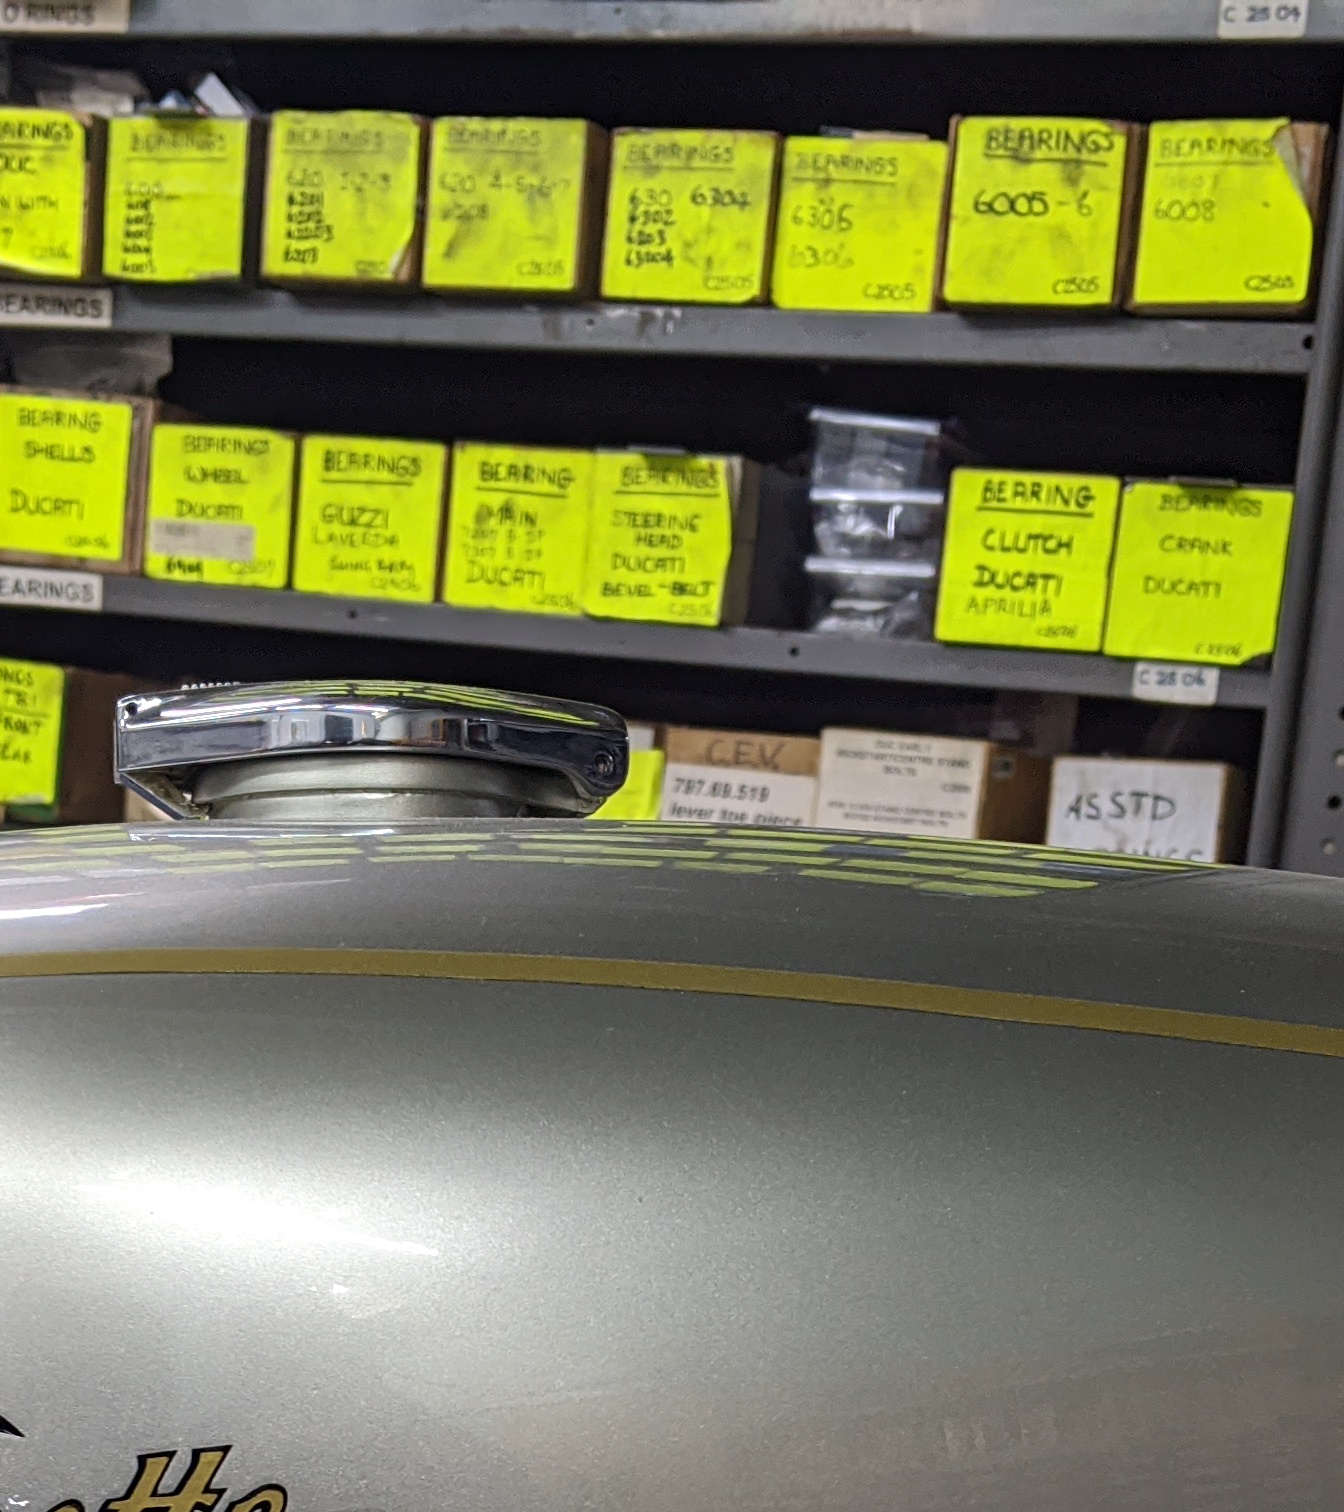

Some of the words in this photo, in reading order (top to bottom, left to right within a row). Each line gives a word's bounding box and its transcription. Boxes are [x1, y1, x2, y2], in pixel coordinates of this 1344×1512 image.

[985, 126, 1117, 154] BEARINGS
[480, 460, 576, 490] BEARING
[8, 488, 85, 520] DUCATI
[980, 479, 1097, 510] BEARING
[320, 502, 390, 531] GUZZI
[980, 527, 1075, 557] CLUTCH
[1157, 532, 1234, 558] CRANK
[466, 559, 546, 591] DUCATI
[611, 551, 686, 575] DUCATI
[971, 562, 1064, 599] DUCATI
[1142, 574, 1224, 600] DUCATI
[1065, 789, 1178, 822] ASSTD
